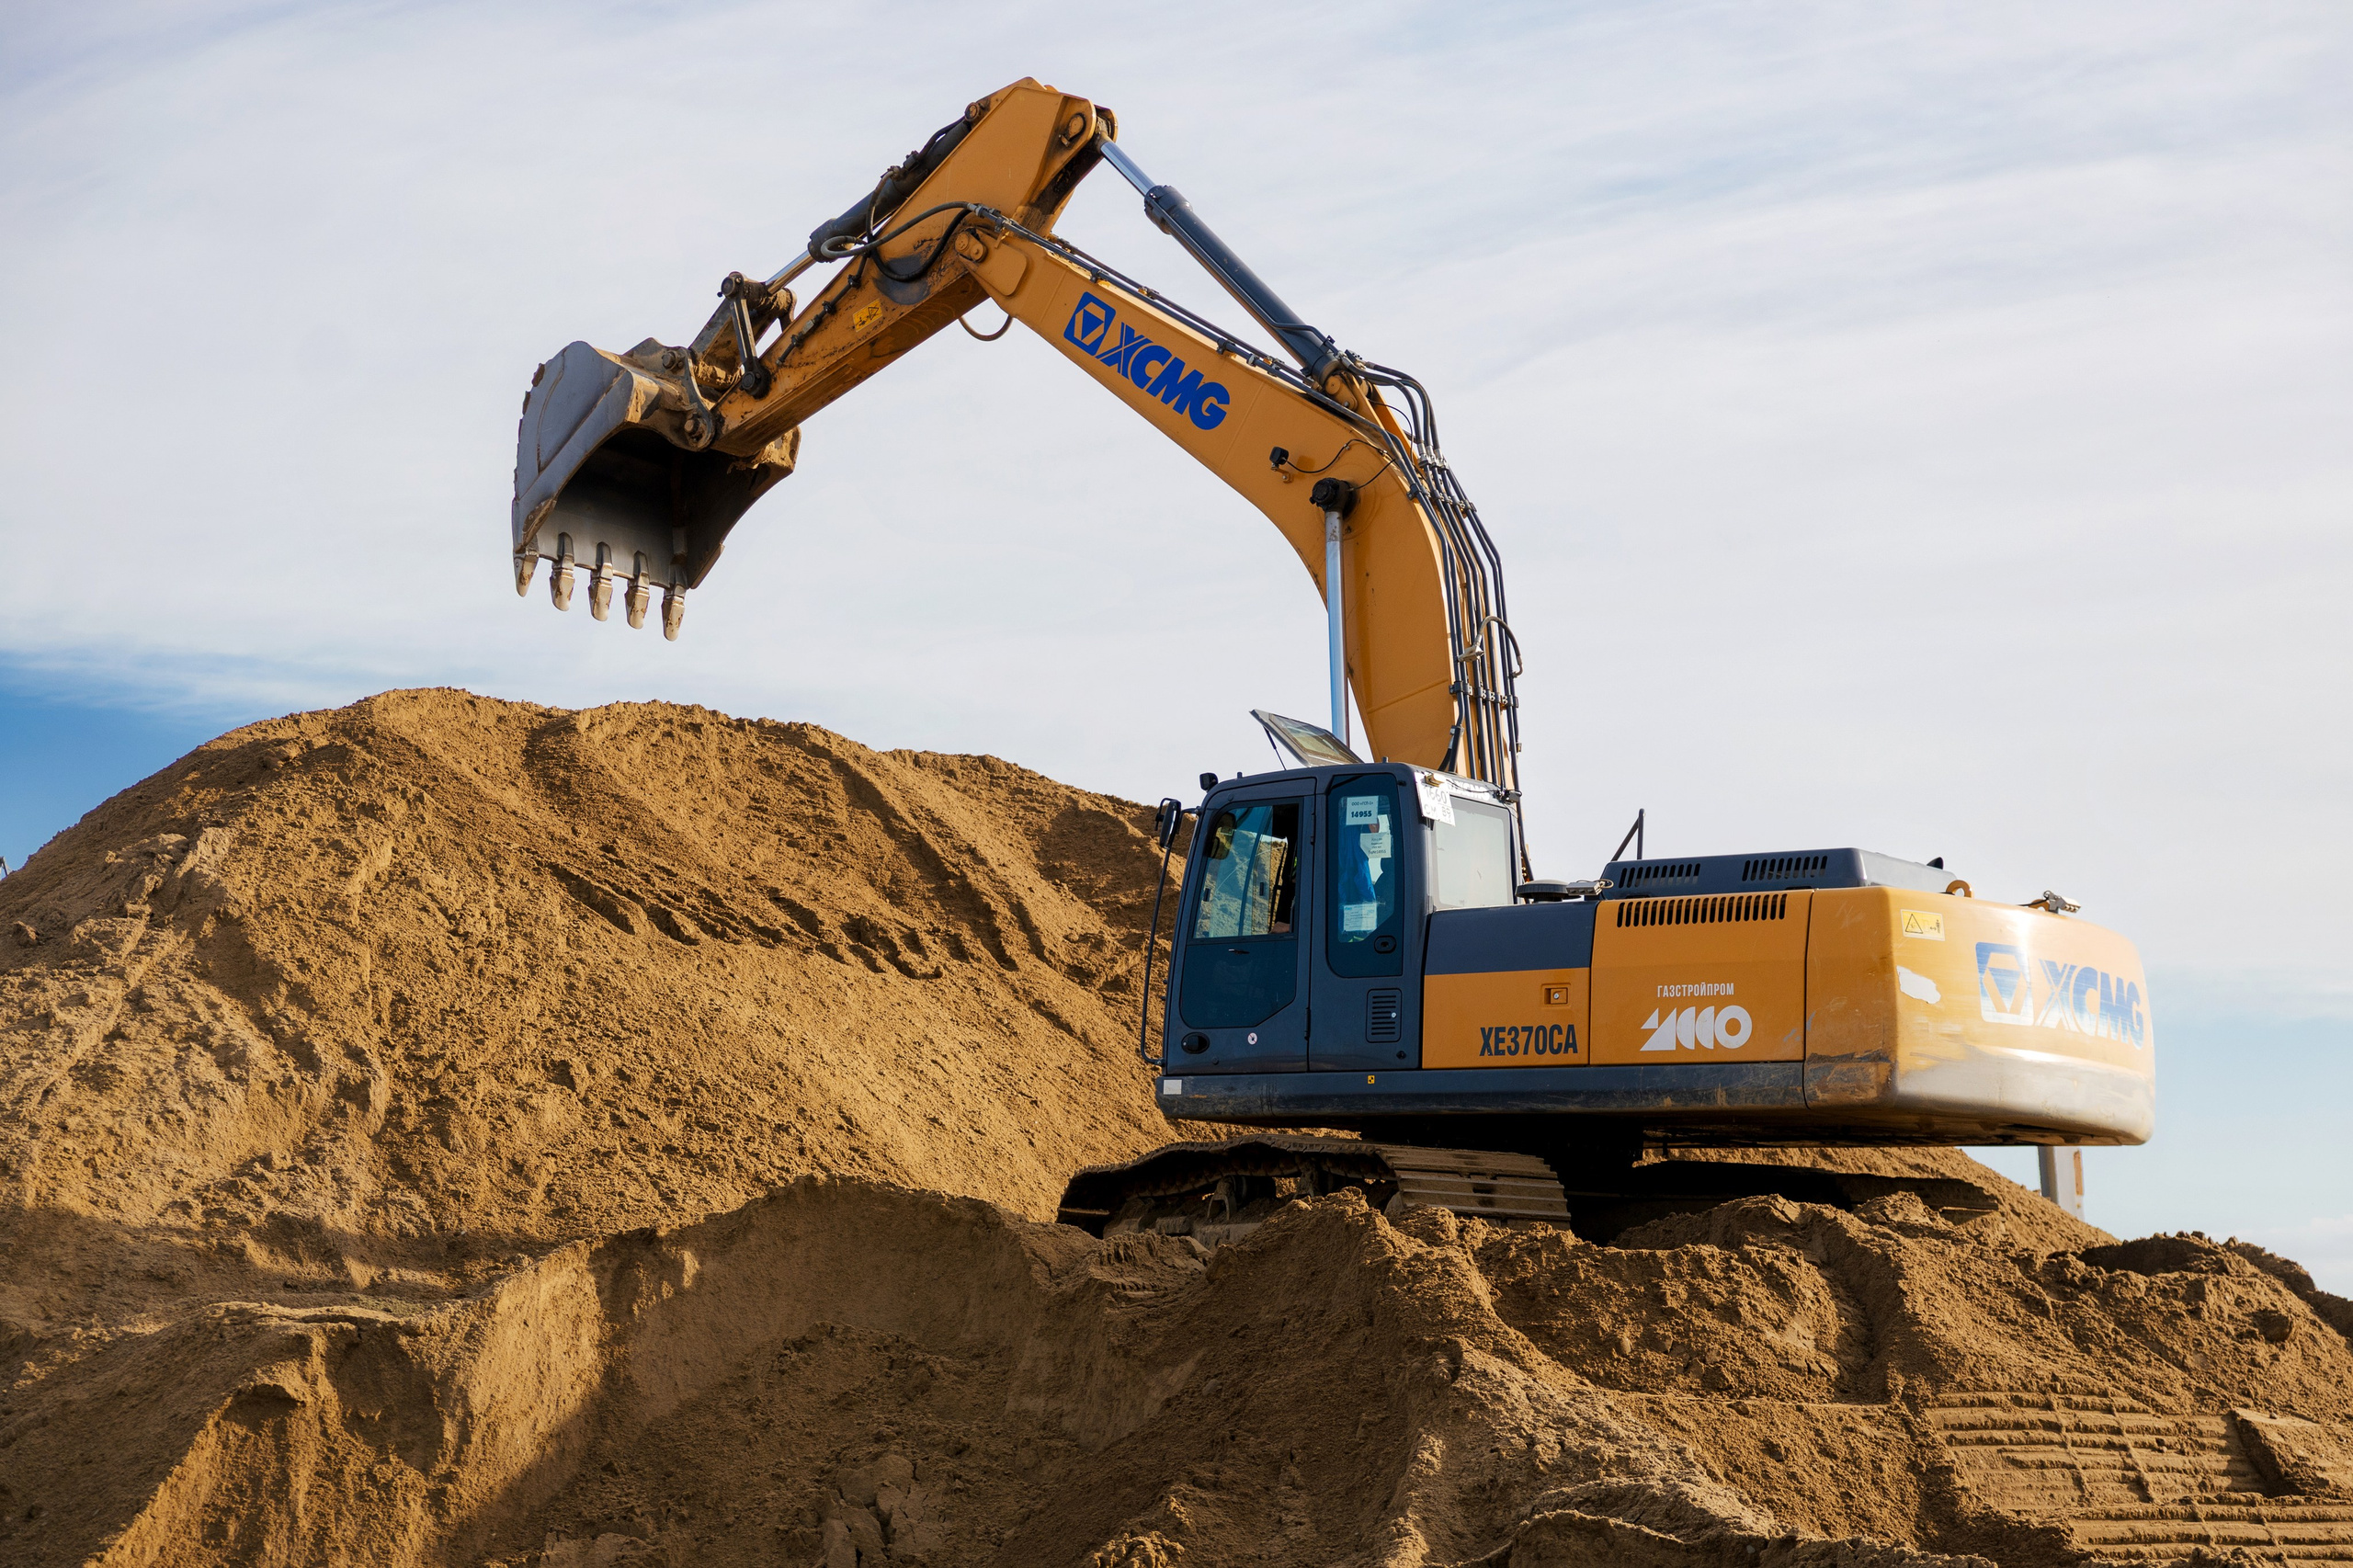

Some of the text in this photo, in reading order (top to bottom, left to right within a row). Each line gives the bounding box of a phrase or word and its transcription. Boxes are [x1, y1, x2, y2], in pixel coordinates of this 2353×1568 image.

[1095, 322, 1231, 431] XCMG
[1351, 810, 1372, 818] 14955
[1657, 982, 1734, 998] ГАЗСТРОЙПРОМ
[2035, 958, 2144, 1051] XCMG
[1479, 1024, 1578, 1056] XE370CA
